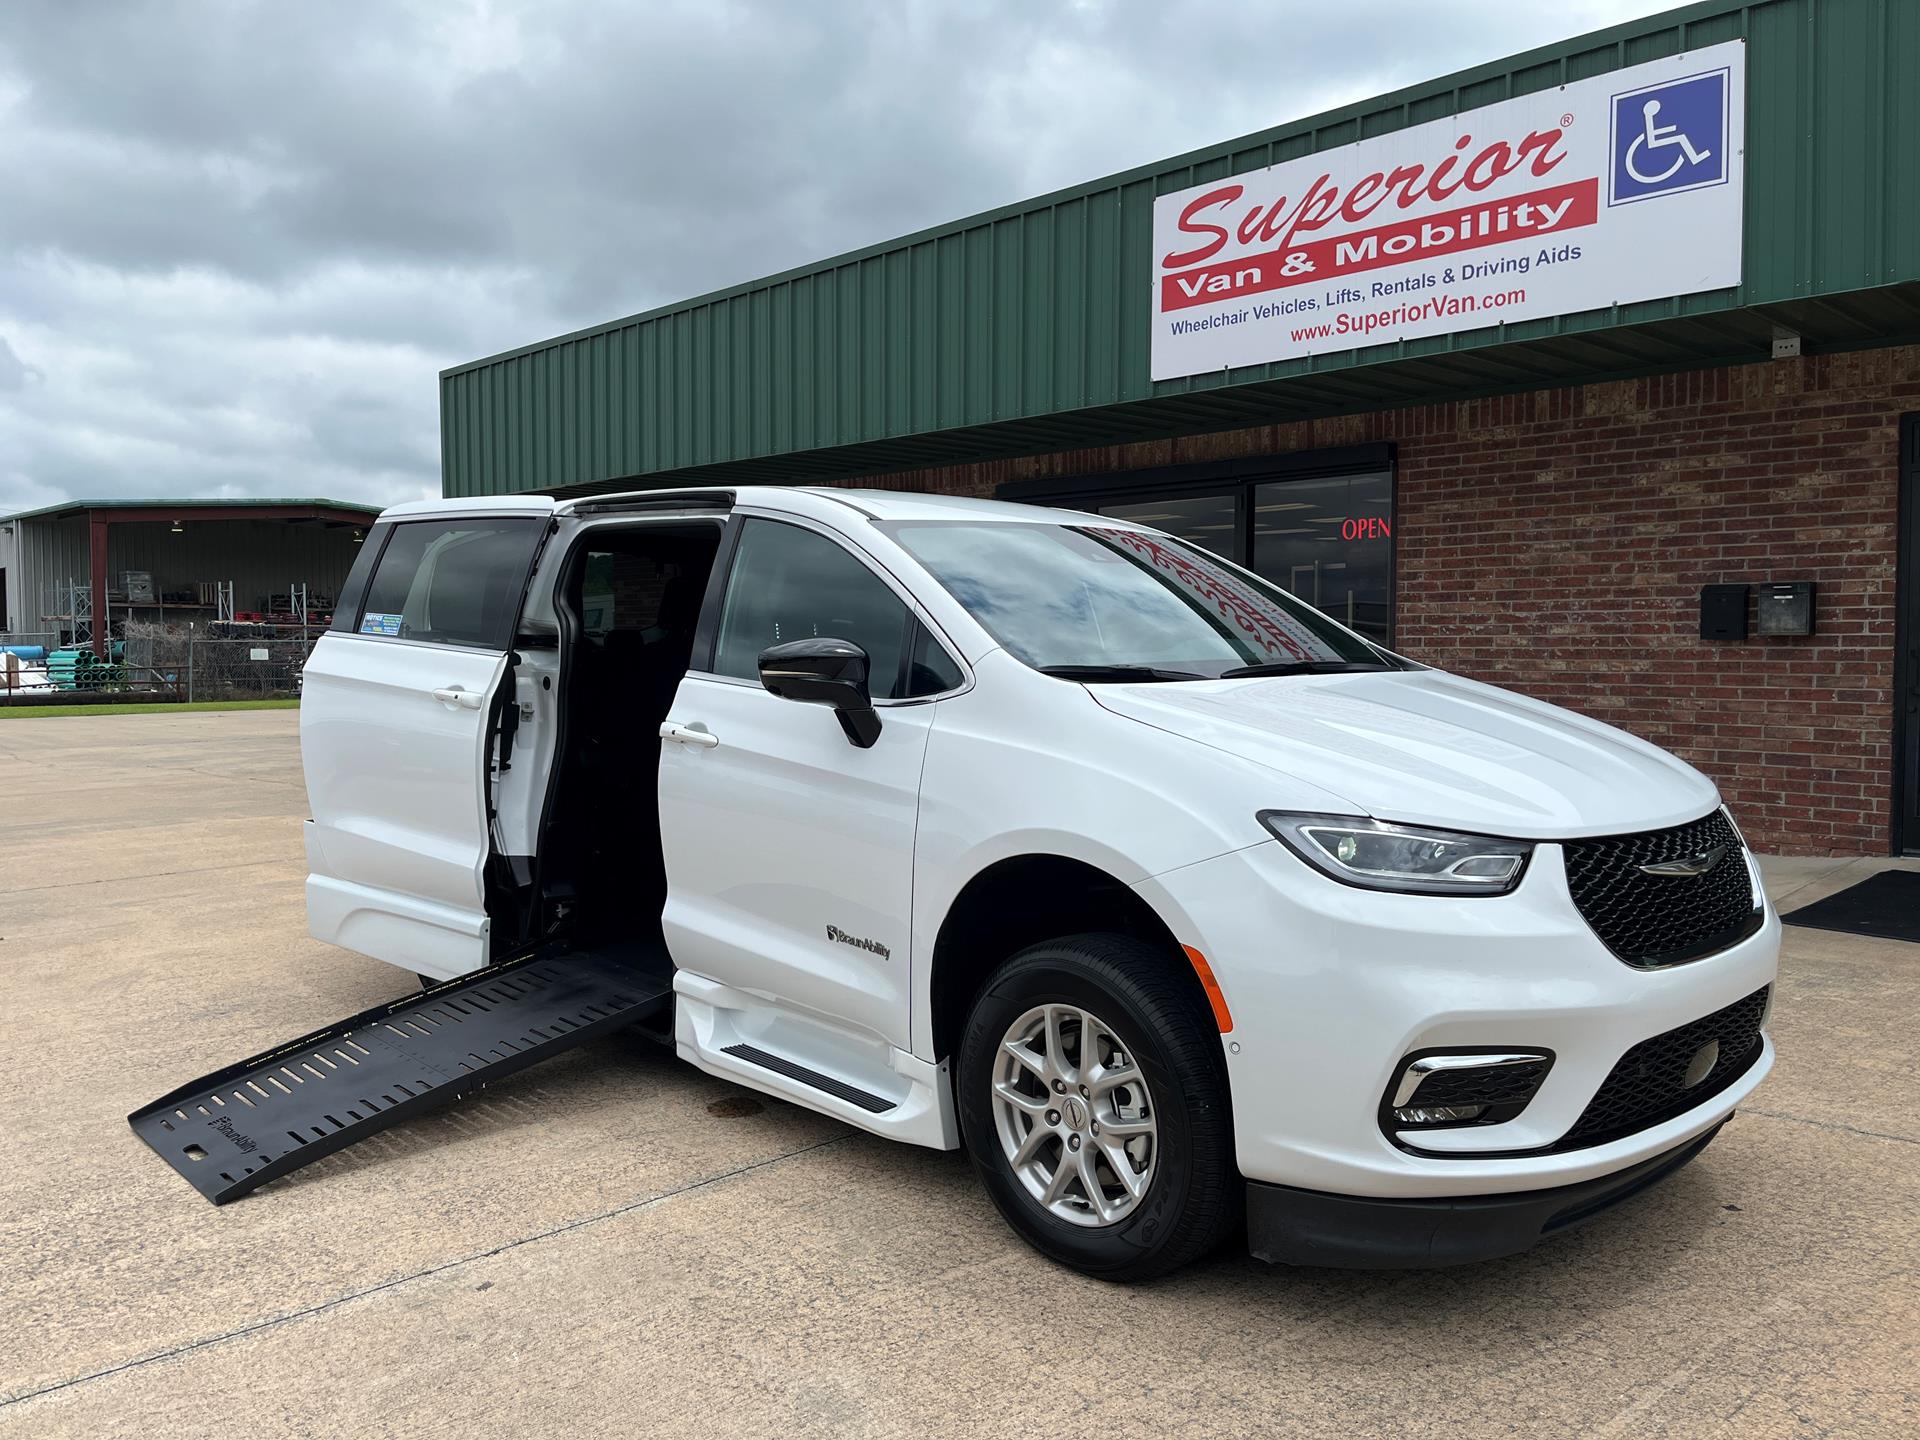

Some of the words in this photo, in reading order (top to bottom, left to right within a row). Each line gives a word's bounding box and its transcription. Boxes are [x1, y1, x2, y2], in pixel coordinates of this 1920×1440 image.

[1162, 128, 1567, 268] Superior
[1177, 267, 1262, 298] Van
[1280, 252, 1317, 278] &
[1335, 197, 1575, 266] Mobility
[1171, 309, 1249, 336] Wheelchair
[1253, 297, 1321, 320] Vehicles,
[1326, 288, 1366, 306] Lifts,
[1371, 273, 1437, 298] Rentals
[1442, 268, 1455, 284] &
[1462, 256, 1530, 281] Driving
[1536, 245, 1582, 267] Aids
[1290, 289, 1527, 342] www.SuperiorVan.com
[1342, 517, 1391, 541] OPEN
[838, 929, 891, 961] BraunAbility
